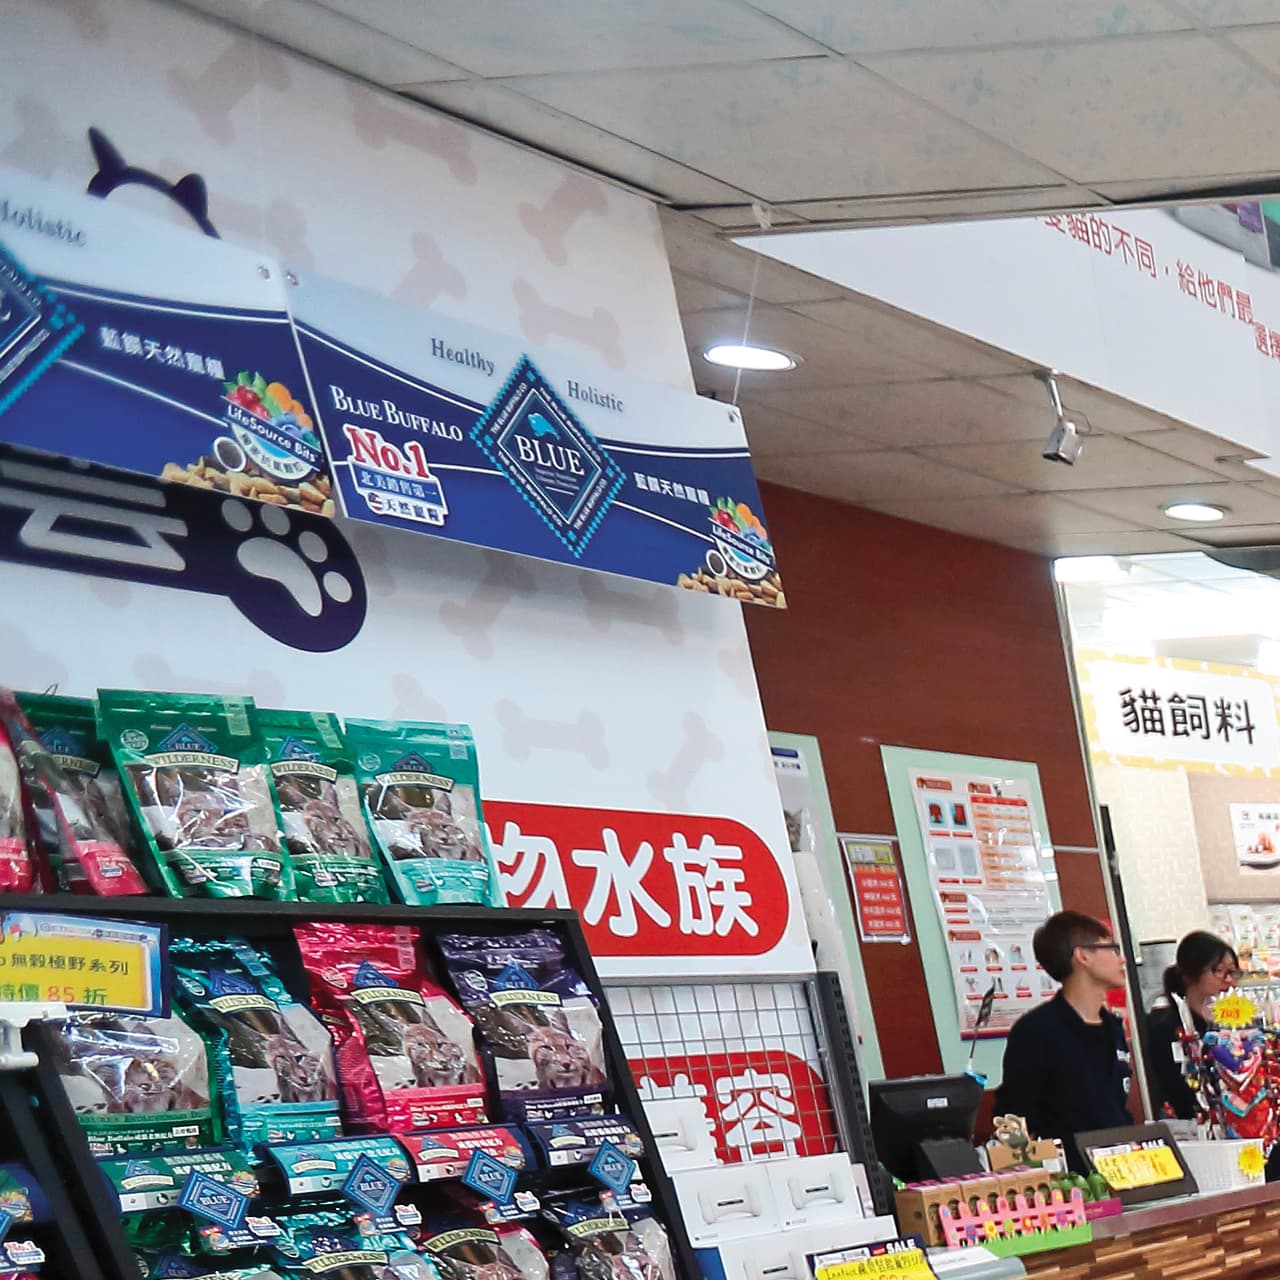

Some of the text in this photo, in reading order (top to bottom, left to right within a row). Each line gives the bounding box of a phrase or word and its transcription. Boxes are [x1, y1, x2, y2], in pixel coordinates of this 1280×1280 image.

[431, 337, 496, 377] Healthy
[567, 380, 625, 414] Holistic
[329, 384, 463, 442] BLUE BUFFALO
[227, 404, 293, 451] LifeSource
[294, 439, 318, 463] Bits
[345, 426, 430, 479] No.1
[514, 433, 585, 477] BLUE
[1119, 687, 1257, 746] 貓飼料
[150, 753, 238, 773] WILDERNESS
[274, 762, 337, 780] WILDERNESS
[11, 952, 129, 976] 無穀極野系列
[47, 985, 108, 1006] 85 折
[354, 987, 423, 1005] WILDERNESS
[360, 1181, 385, 1192] BLUE
[479, 1170, 502, 1183] BLUE
[200, 1194, 230, 1207] BLUE
[425, 1229, 499, 1251] WILDERNESS
[885, 1238, 916, 1255] SALE
[307, 1251, 388, 1273] WILDERNESS
